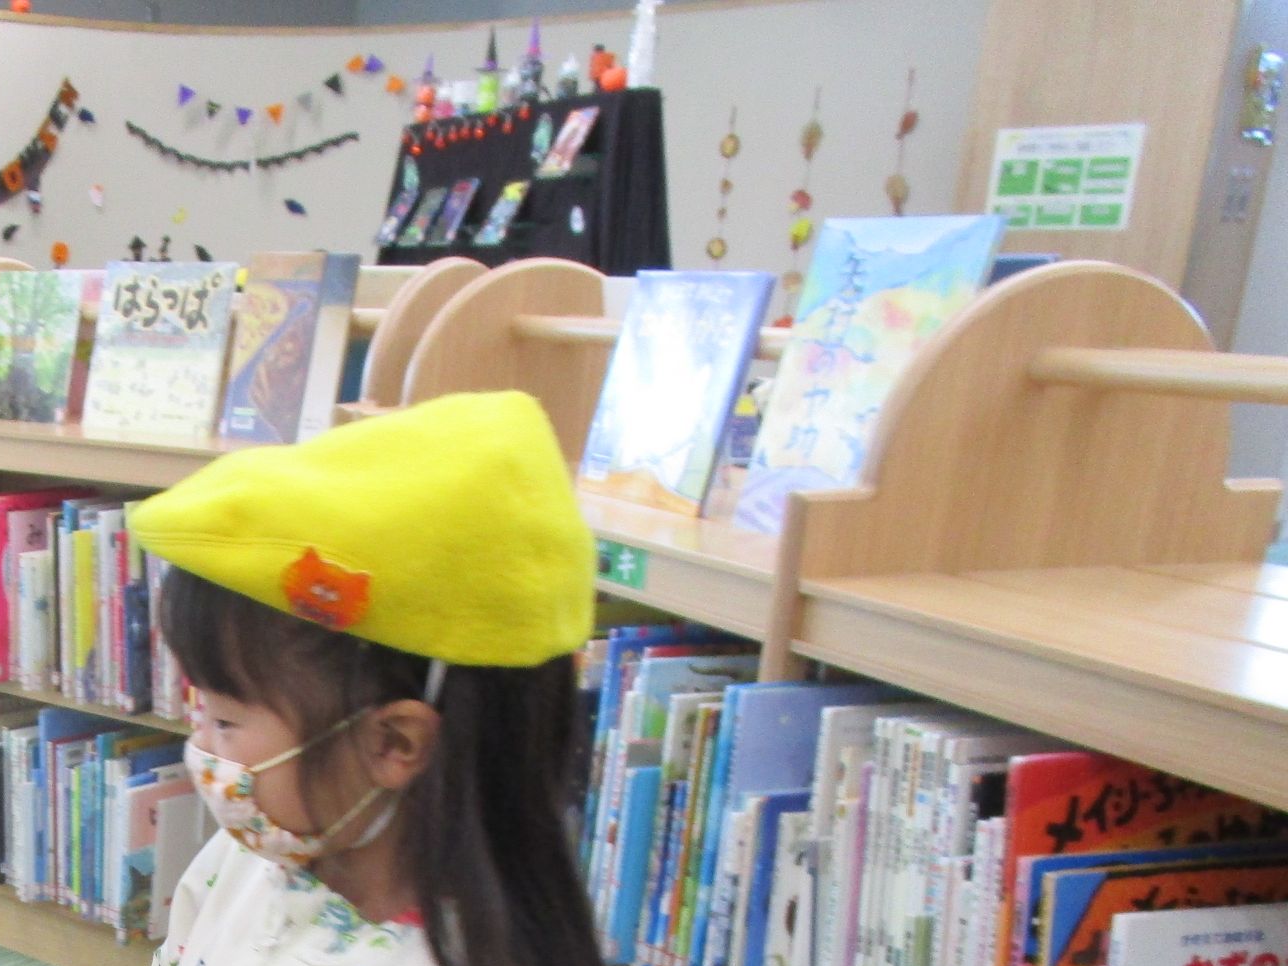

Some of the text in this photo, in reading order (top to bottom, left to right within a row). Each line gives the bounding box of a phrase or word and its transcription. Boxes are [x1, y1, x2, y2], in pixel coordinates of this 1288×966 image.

[113, 271, 222, 330] はらっぱ
[615, 548, 637, 581] キ
